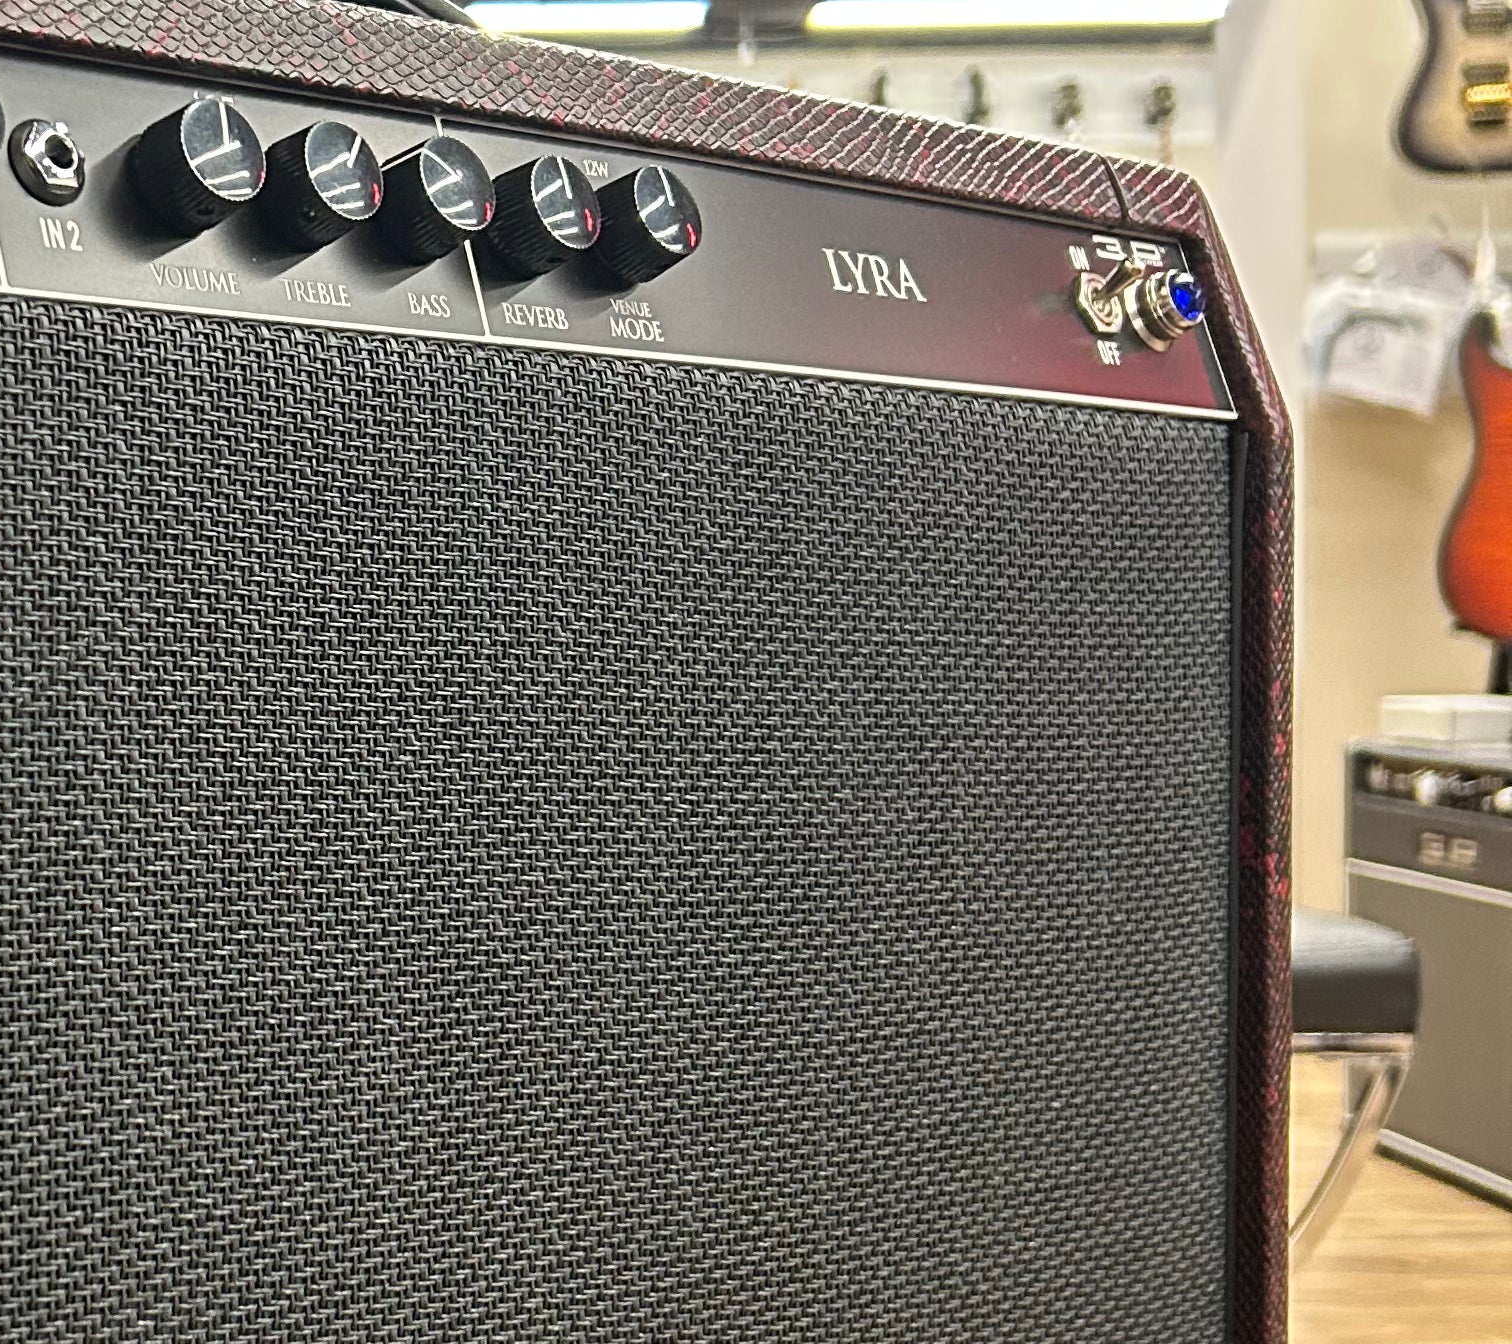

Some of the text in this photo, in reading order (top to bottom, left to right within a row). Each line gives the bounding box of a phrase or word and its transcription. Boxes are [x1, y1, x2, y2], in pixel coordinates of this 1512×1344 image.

[582, 159, 609, 178] 12W
[149, 263, 241, 296] VOLUME
[821, 247, 927, 303] LYRA
[282, 277, 352, 309] TREBLE
[407, 292, 452, 319] BASS
[501, 301, 570, 330] REVERB
[609, 298, 653, 318] VENUE
[609, 316, 665, 343] MODE
